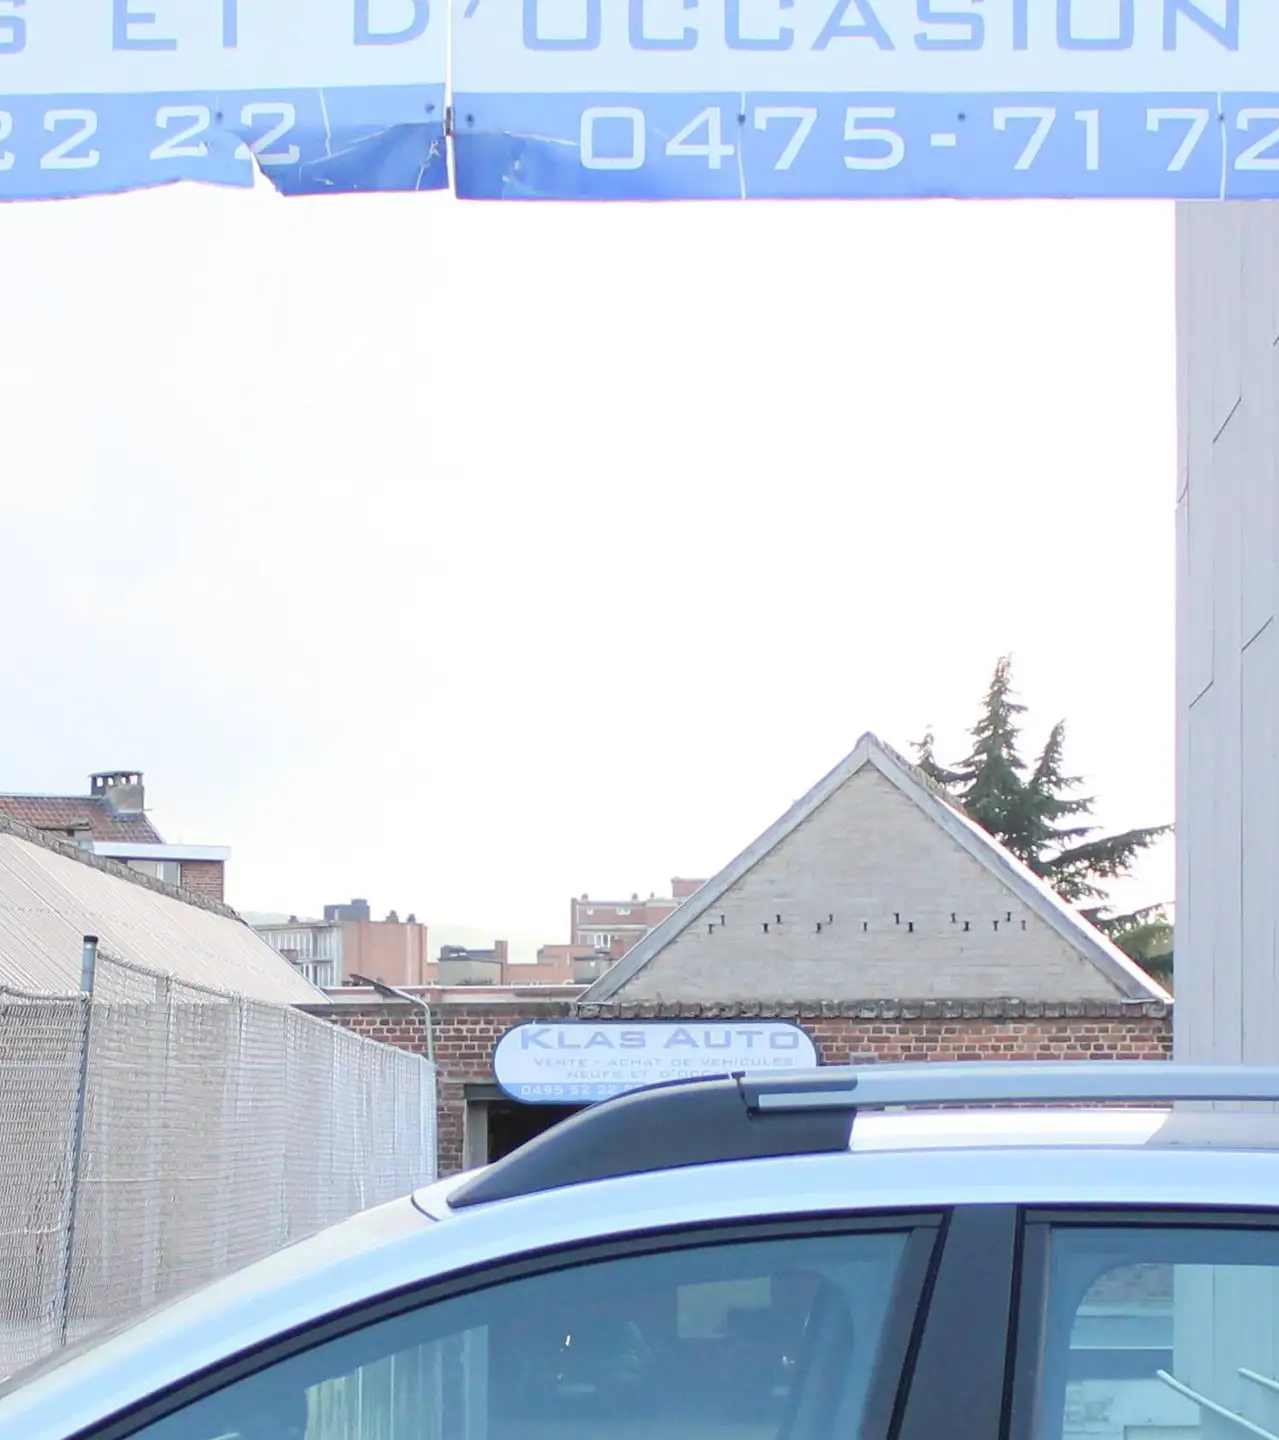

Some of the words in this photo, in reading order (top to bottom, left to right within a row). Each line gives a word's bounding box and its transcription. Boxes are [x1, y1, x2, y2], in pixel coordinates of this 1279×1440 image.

[149, 102, 300, 169] 22
[521, 1027, 647, 1050] KLAS
[663, 1027, 800, 1050] AUTO
[533, 1058, 588, 1068] VENTE
[608, 1058, 663, 1068] ACHAT
[670, 1058, 692, 1067] DE
[566, 1069, 622, 1080] NEUFS
[630, 1069, 649, 1079] ET
[521, 1084, 564, 1096] 0495
[569, 1084, 591, 1096] 52
